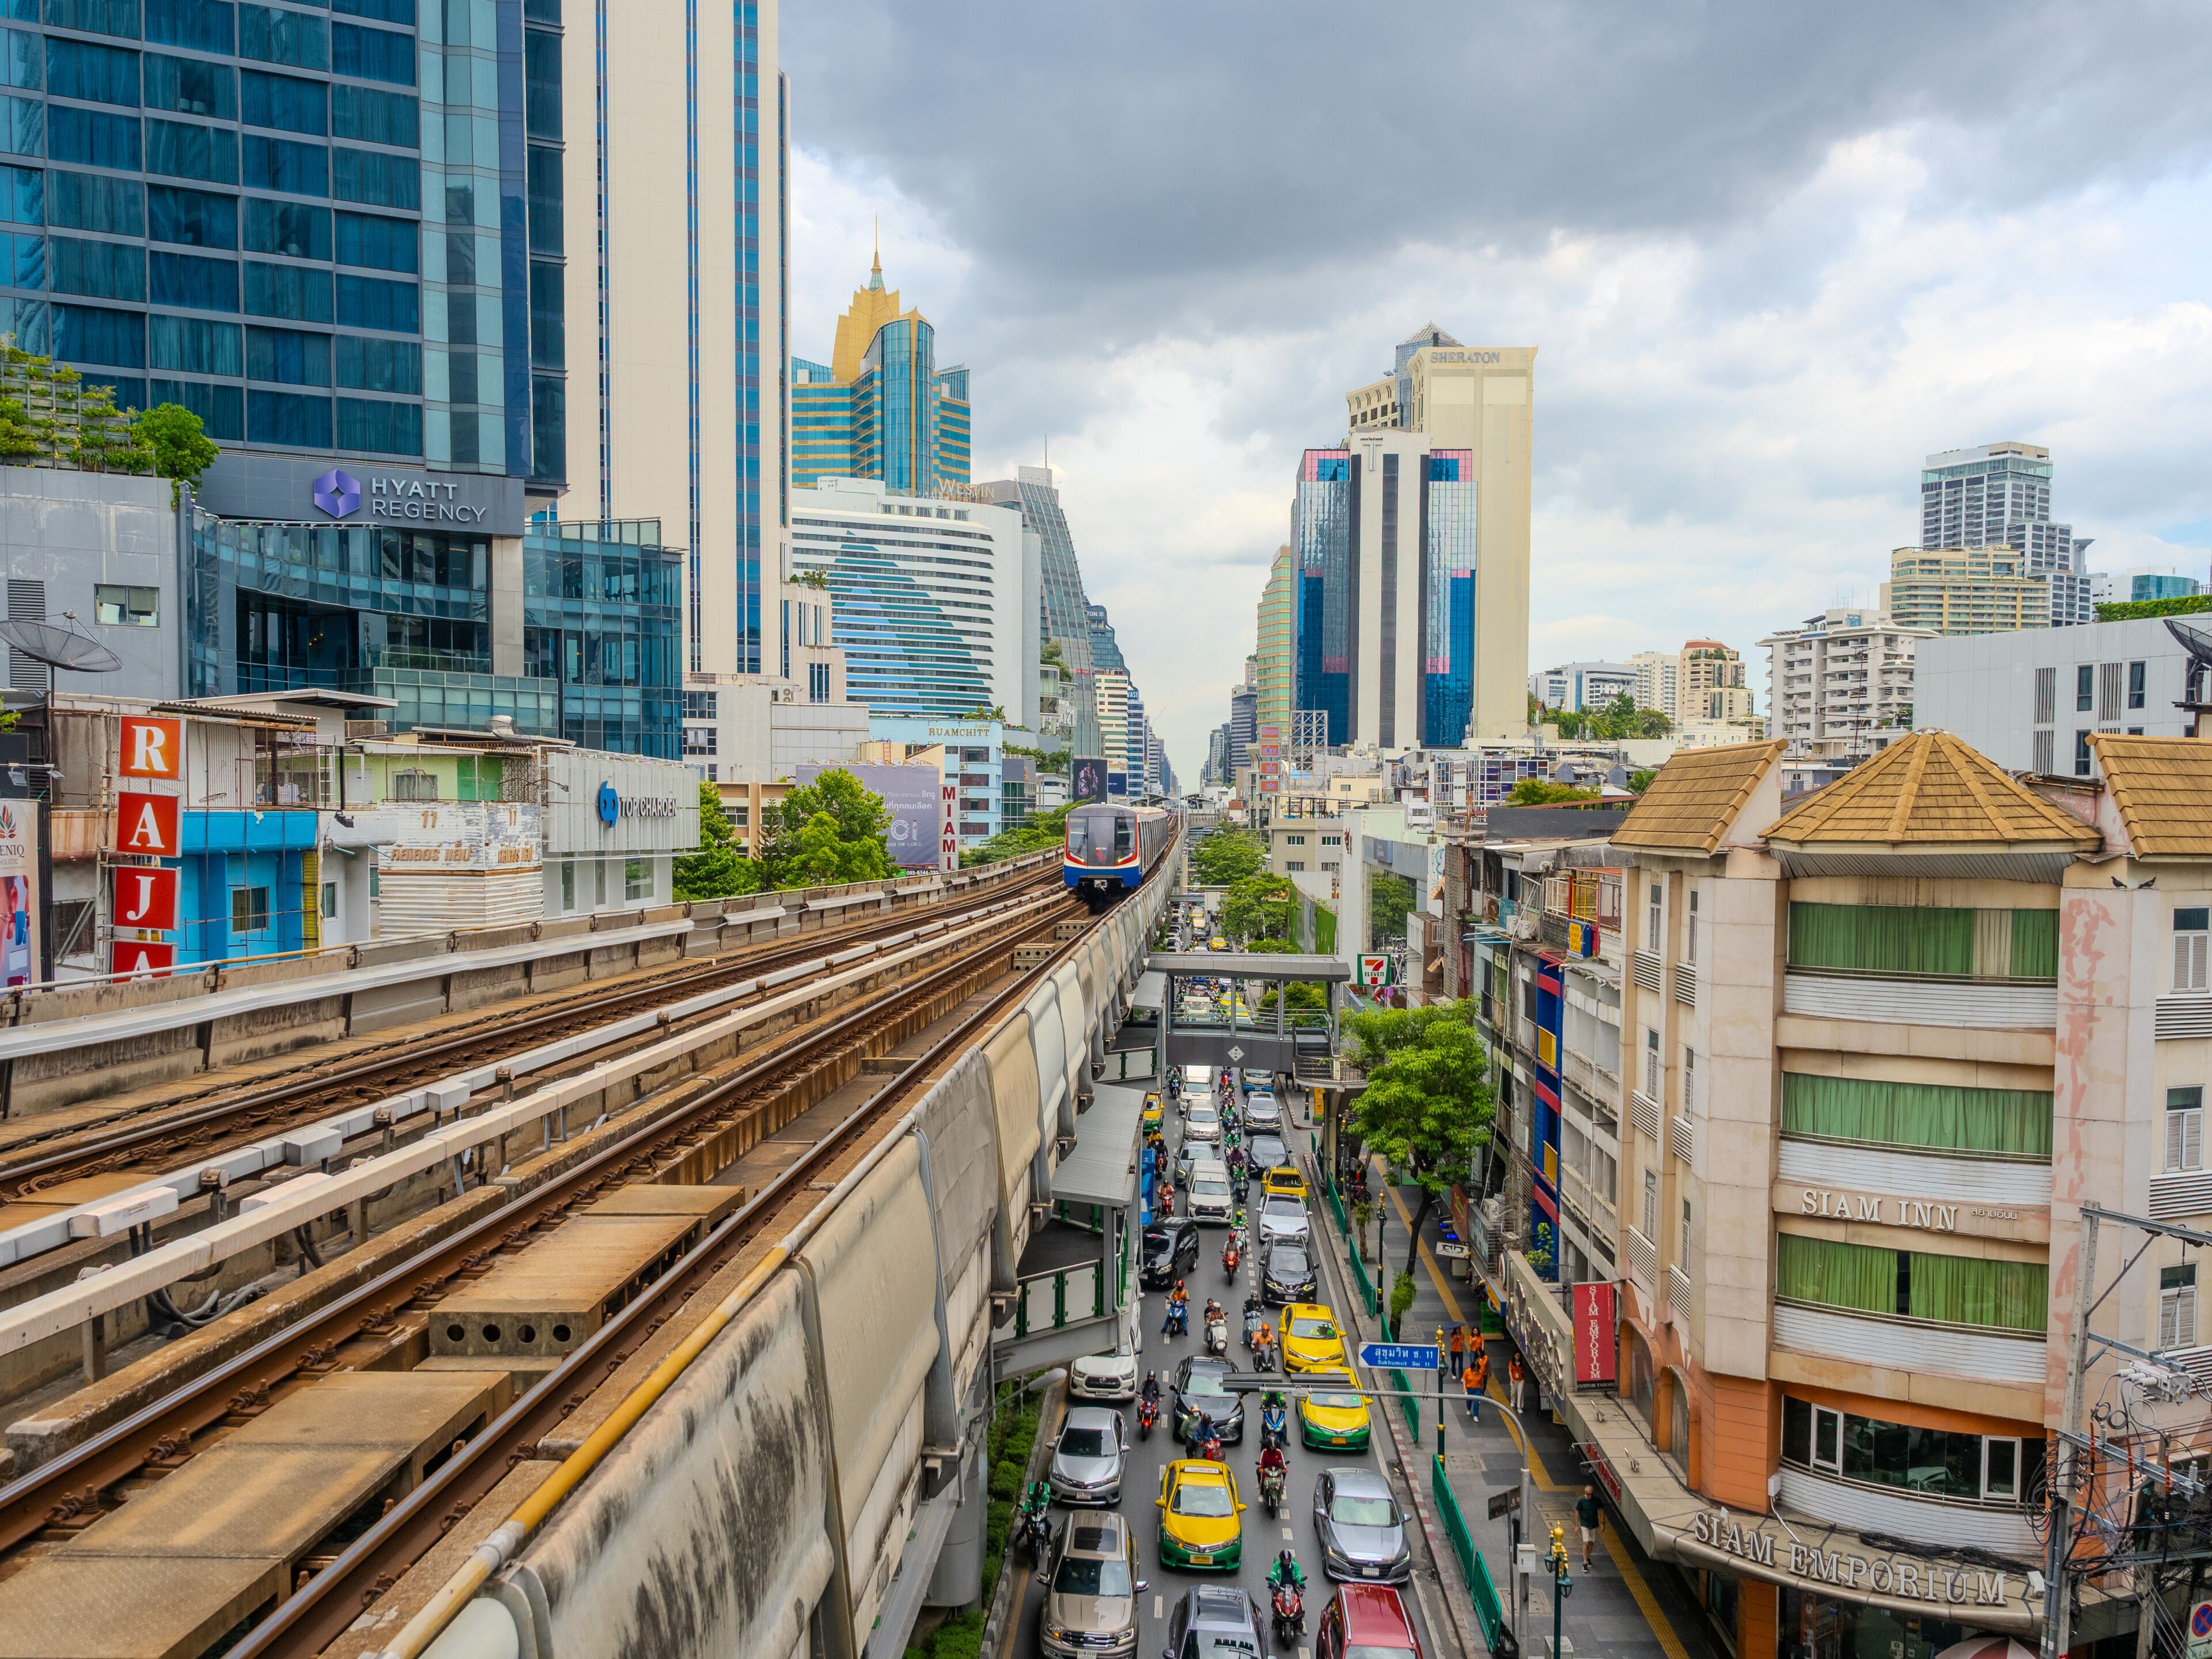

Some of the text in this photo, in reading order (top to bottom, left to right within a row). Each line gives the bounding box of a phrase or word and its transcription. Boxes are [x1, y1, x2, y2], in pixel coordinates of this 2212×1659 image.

[1430, 352, 1500, 363] SHERATON
[372, 477, 457, 500] HYATT
[372, 499, 487, 522] REGENCY
[929, 728, 990, 736] RUAMCHITT
[619, 797, 677, 817] TOP CHAROEN
[421, 810, 438, 828] 11
[942, 786, 956, 870] MIAMI
[127, 725, 168, 979] RAJA
[1801, 1190, 1882, 1222] SIAM
[1898, 1200, 1957, 1230] INN
[1588, 1286, 1601, 1378] SIAM EMPORIUM
[1375, 1347, 1408, 1359] สุขุมวิท
[1426, 1351, 1433, 1359] 11
[1694, 1510, 2009, 1607] SIAM EMPORIUM
